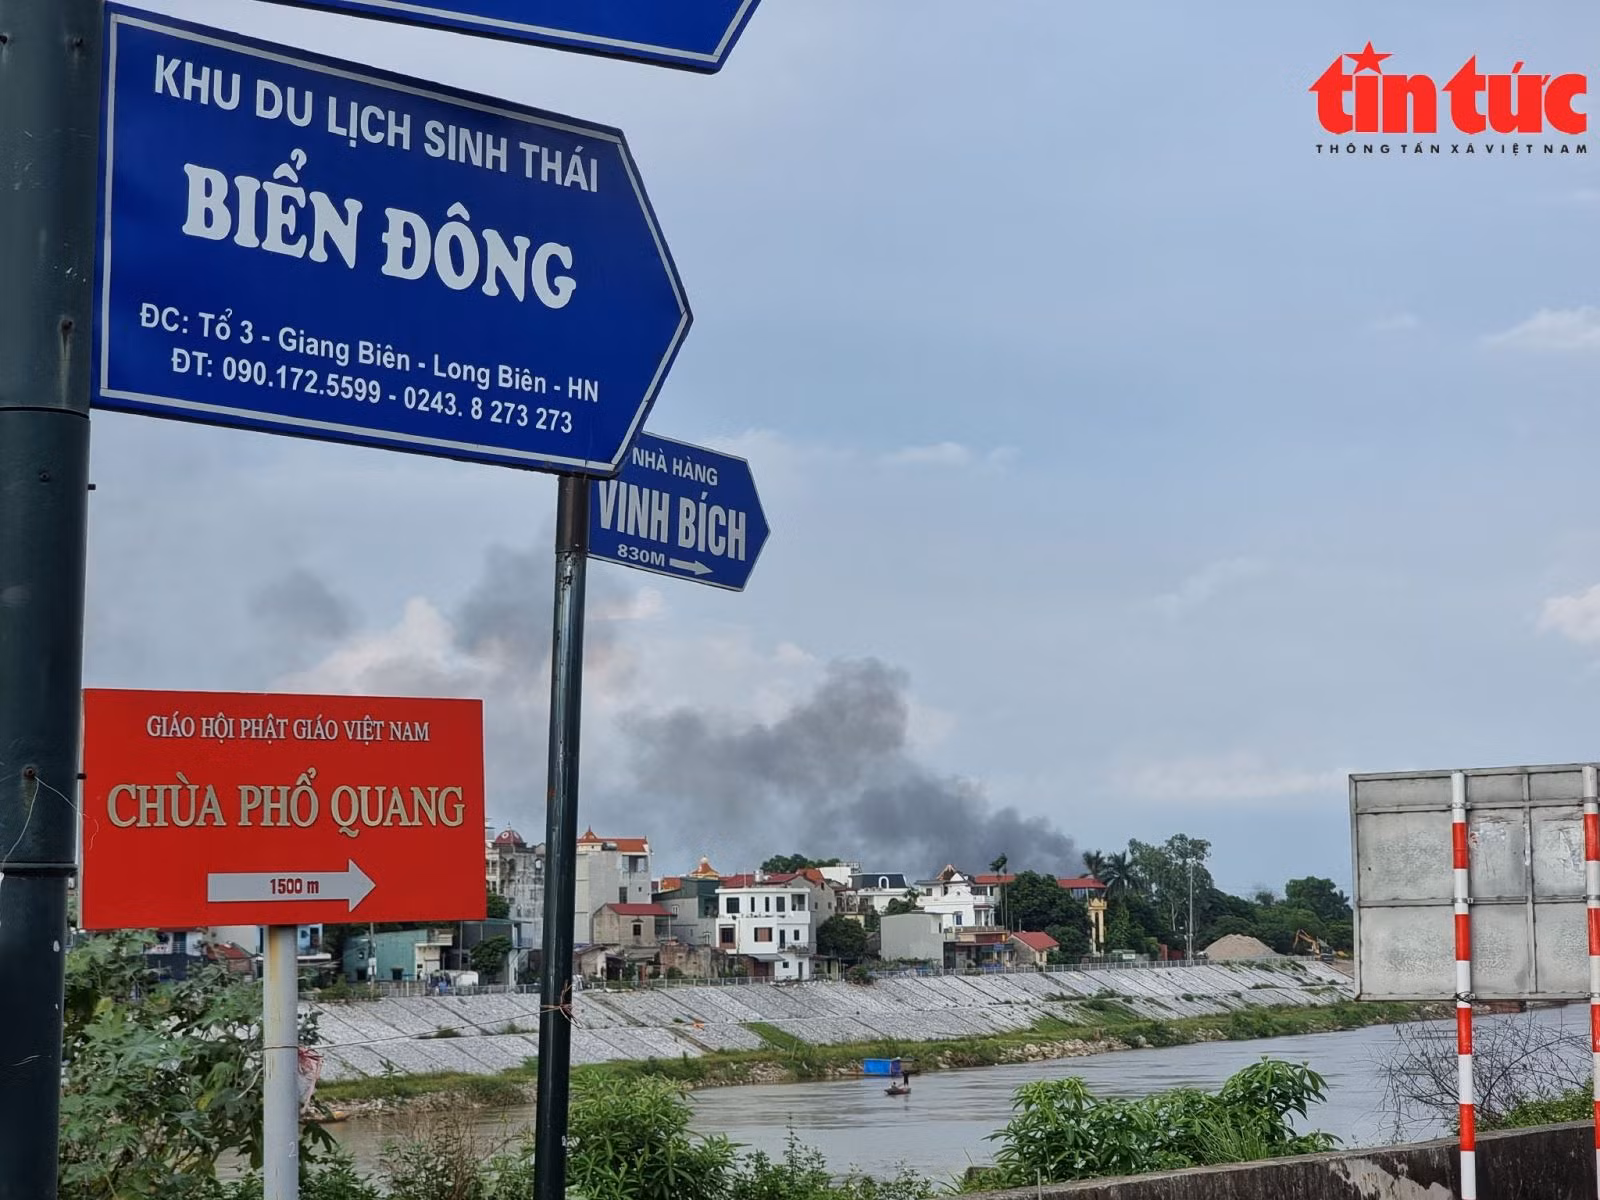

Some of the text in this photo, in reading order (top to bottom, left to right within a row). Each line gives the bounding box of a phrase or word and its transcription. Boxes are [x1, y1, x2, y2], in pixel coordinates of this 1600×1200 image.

[154, 54, 598, 193] KHU DU LỊCH SINH THÁI
[182, 149, 577, 309] BIỂN ĐÔNG
[140, 302, 188, 334] ĐC:
[198, 308, 233, 341] Tổ
[239, 320, 254, 344] 3
[278, 326, 350, 367] Giang
[358, 340, 410, 372] Biên
[433, 354, 490, 390] Long
[498, 364, 546, 394] Biên
[568, 376, 598, 403] HN
[171, 347, 213, 377] ĐT:
[222, 356, 381, 404] 090.172.5599
[404, 386, 463, 417] 0243.
[470, 397, 483, 420] 8
[490, 400, 528, 427] 273
[535, 407, 573, 433] 273
[632, 447, 718, 486] NHÀ HÀNG
[598, 479, 746, 561] VINH BÍCH
[617, 543, 665, 567] 830M
[146, 710, 430, 746] GIÁO HỘI PHẬT GIÁO VIỆT NAM
[107, 767, 466, 838] CHÙA PHỔ QUANG
[270, 878, 320, 895] 1500 m
